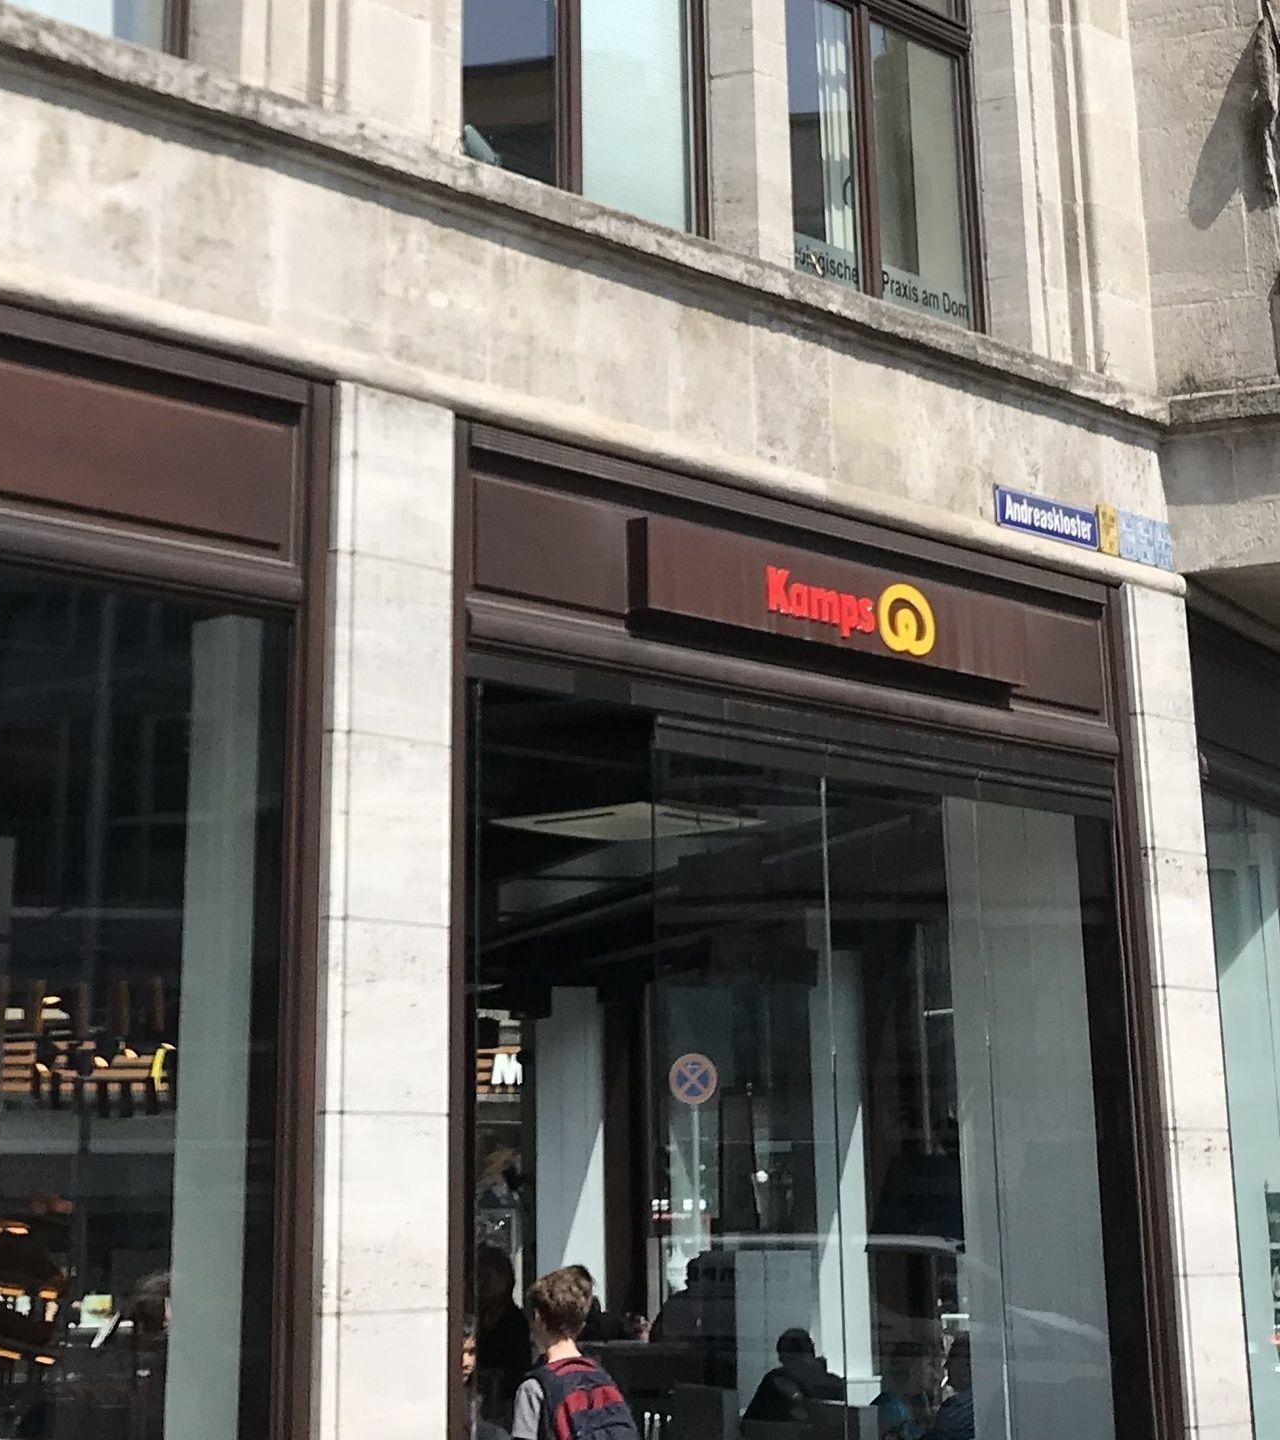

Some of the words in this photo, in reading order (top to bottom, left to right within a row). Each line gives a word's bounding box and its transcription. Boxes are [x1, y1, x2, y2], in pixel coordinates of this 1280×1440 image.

[882, 270, 919, 303] Praxis
[922, 289, 940, 311] am
[943, 291, 970, 320] Dom
[1004, 493, 1093, 542] Andreaskloster
[764, 564, 876, 638] Kamps
